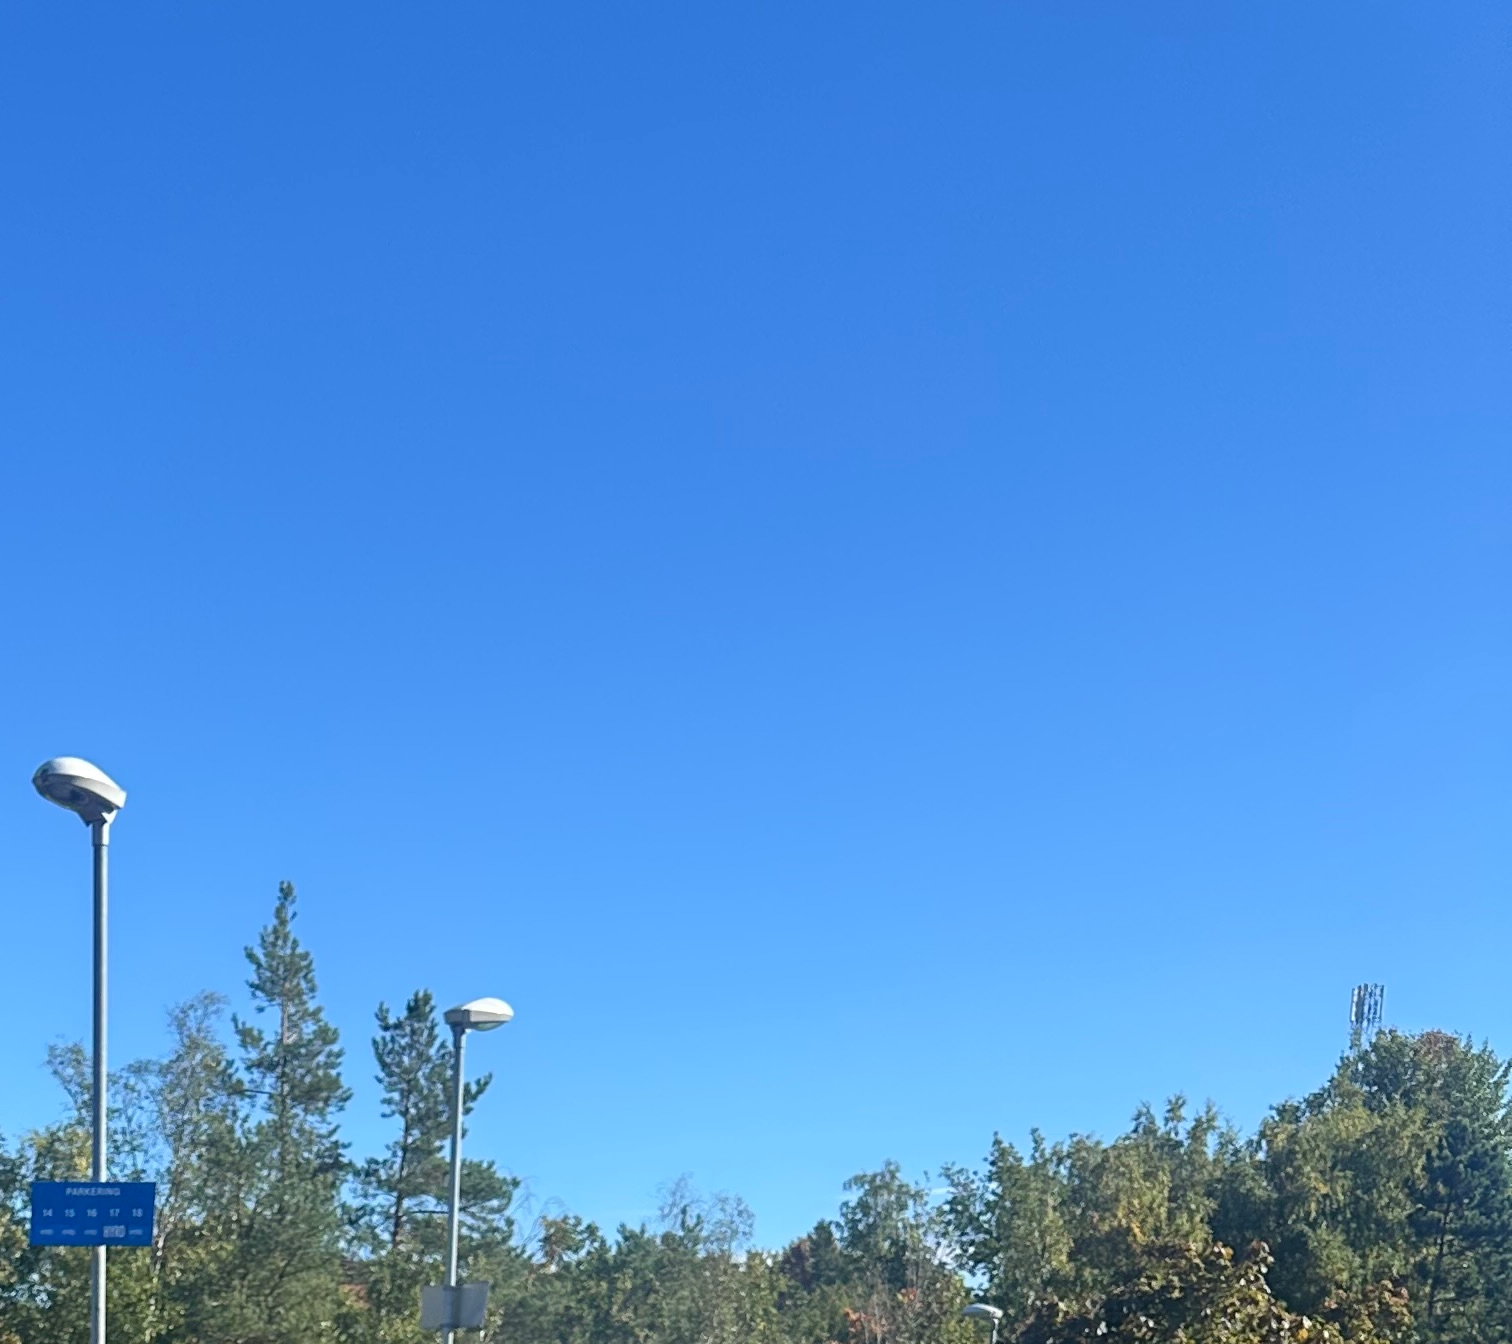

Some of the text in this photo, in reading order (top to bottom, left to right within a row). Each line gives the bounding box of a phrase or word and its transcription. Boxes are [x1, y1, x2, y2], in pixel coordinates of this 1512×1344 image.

[65, 1187, 120, 1196] PARKERING
[42, 1208, 53, 1217] 14
[64, 1208, 75, 1217] 15
[109, 1208, 120, 1217] 17
